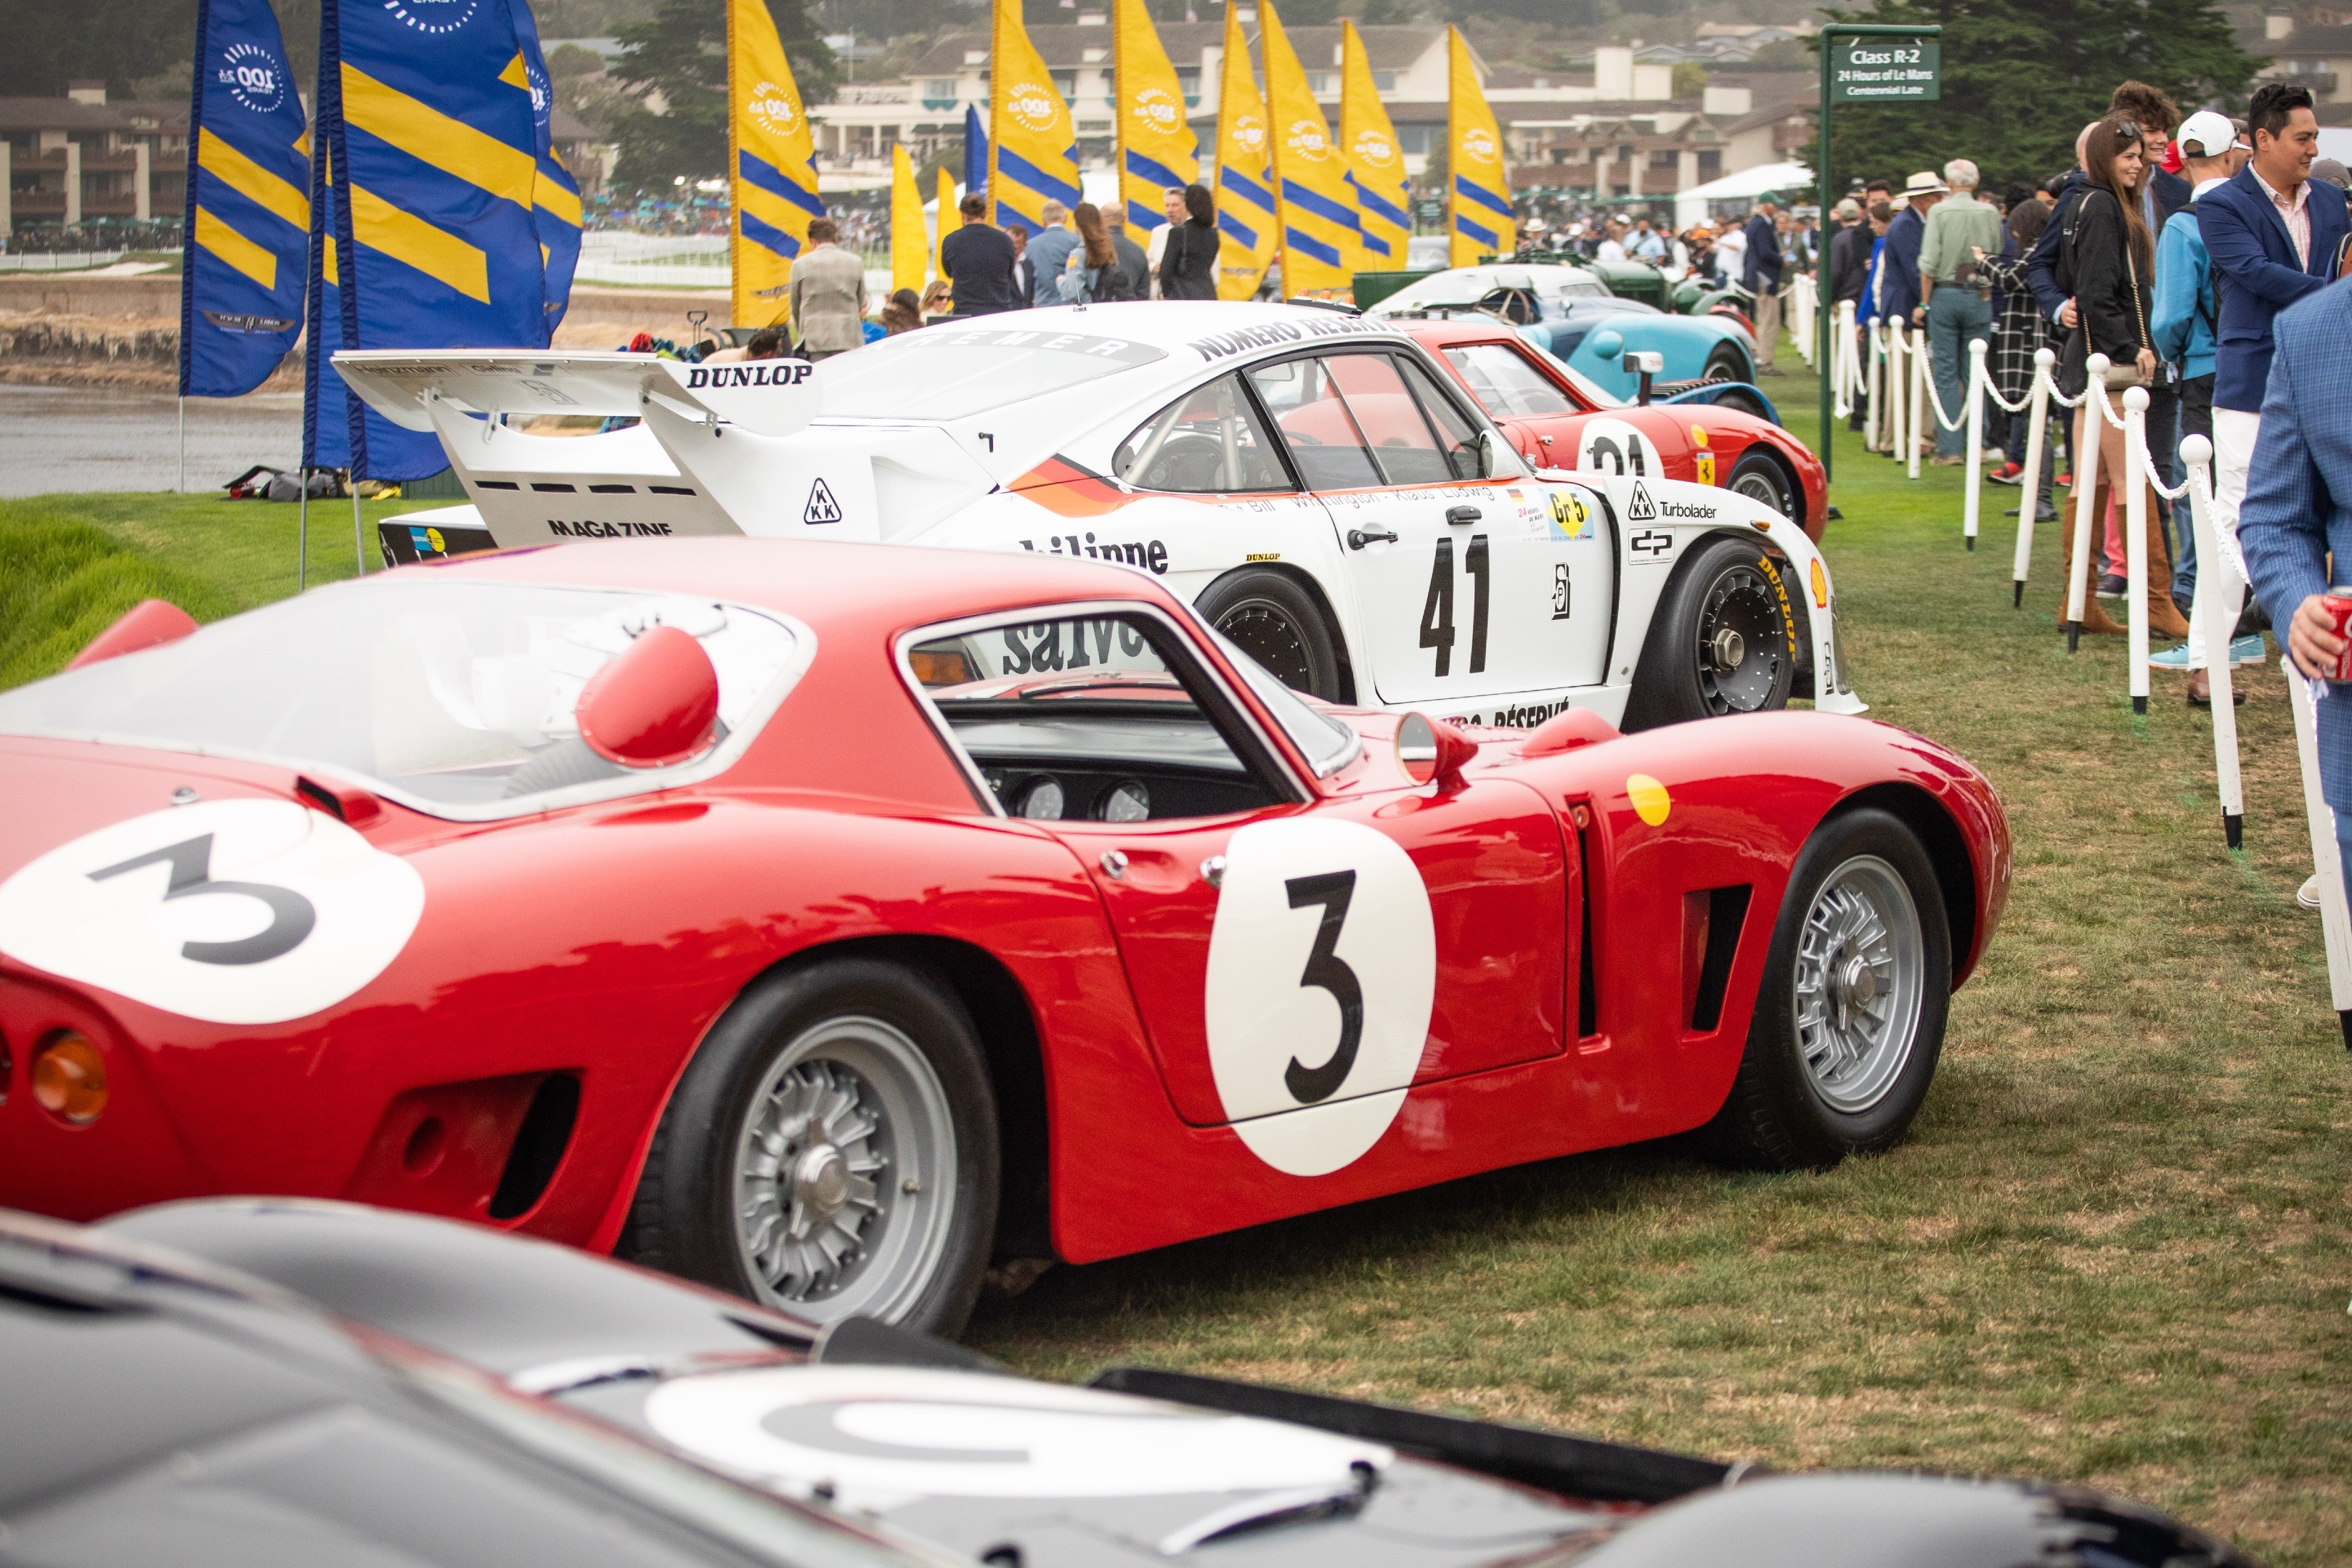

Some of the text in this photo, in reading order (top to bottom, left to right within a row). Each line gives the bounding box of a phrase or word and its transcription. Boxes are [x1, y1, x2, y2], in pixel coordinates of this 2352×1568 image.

[1850, 49, 1921, 65] Class R-2
[1837, 68, 1934, 82] 24 Hours of Le Mans
[1846, 85, 1924, 96] Centennial Late
[1185, 322, 1302, 363] NUMERO
[353, 365, 452, 374] Heinzmann
[687, 365, 813, 388] DUNLOP
[1246, 499, 1276, 513] Bill
[1389, 489, 1435, 501] Klaus
[1438, 486, 1495, 501] Ludwig
[1549, 493, 1585, 523] Gr 5
[1659, 502, 1718, 519] Turbolader
[1518, 507, 1527, 518] 24
[547, 520, 674, 538] MAGAZINE
[1420, 534, 1490, 677] 41
[1757, 555, 1797, 663] DUNLOP
[85, 832, 317, 966] 3
[1283, 869, 1363, 1105] 3
